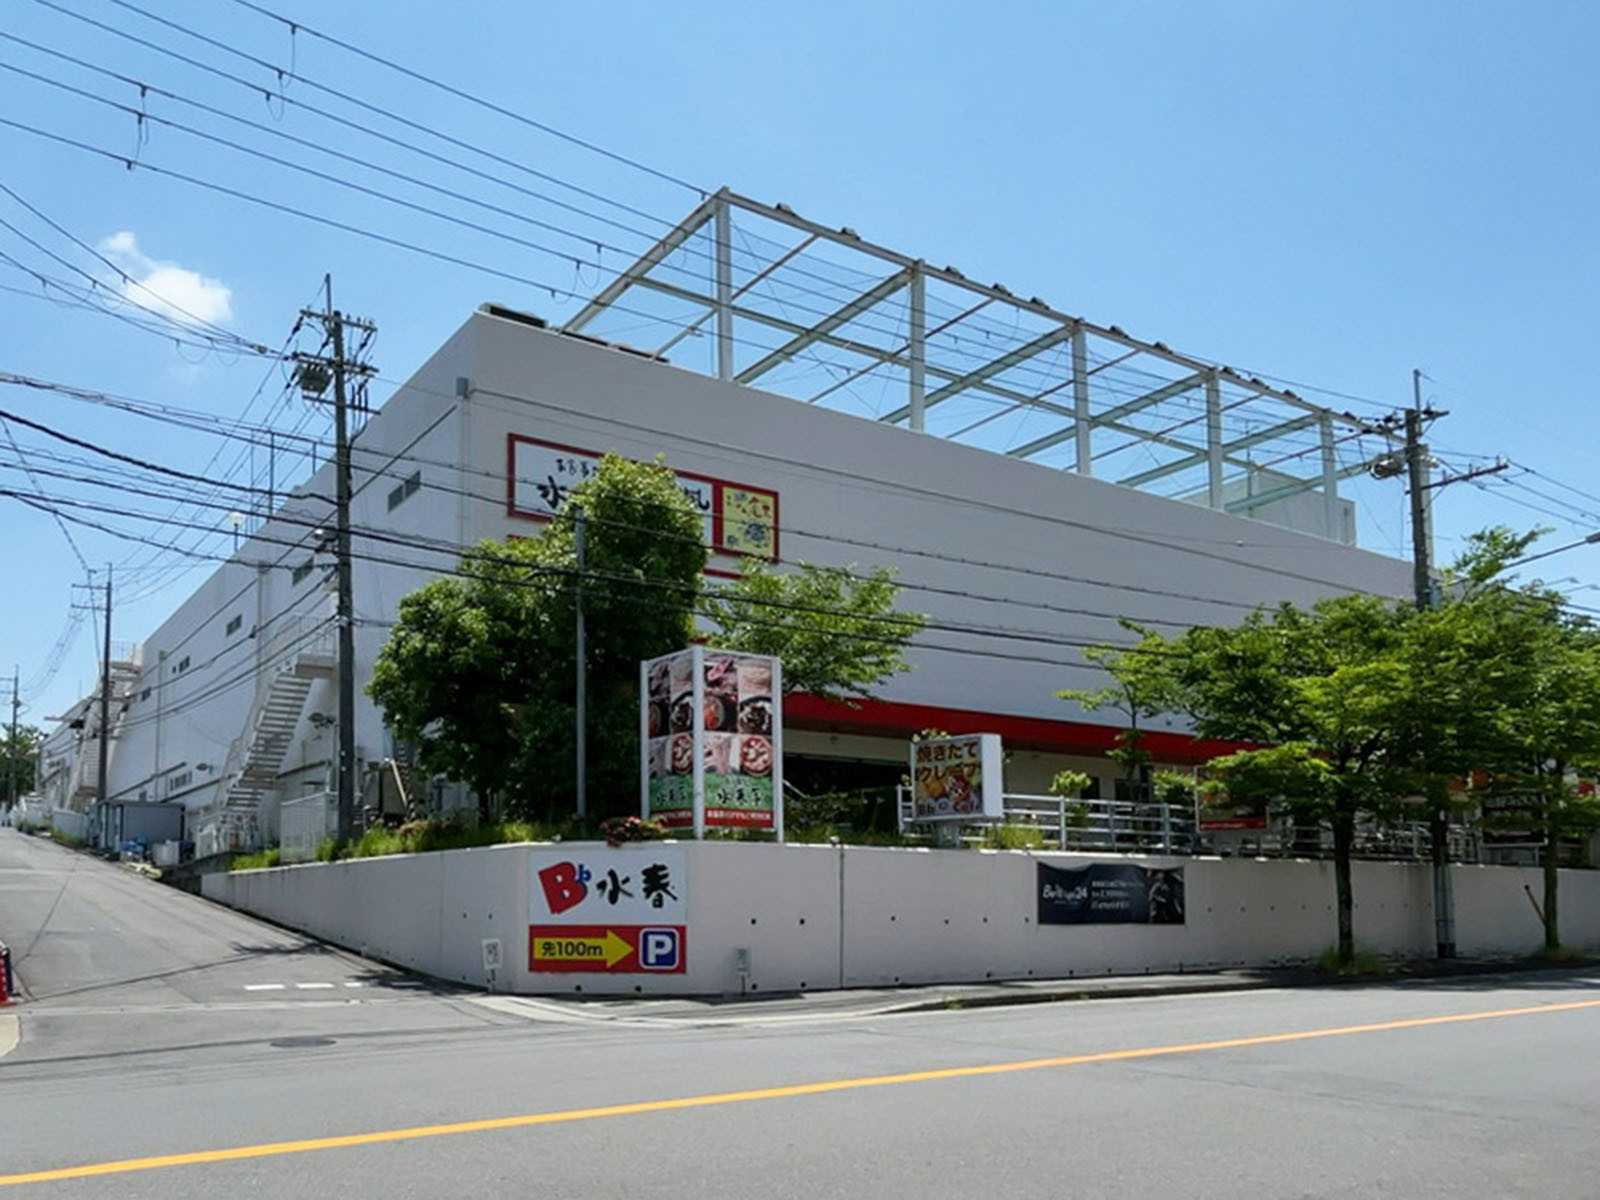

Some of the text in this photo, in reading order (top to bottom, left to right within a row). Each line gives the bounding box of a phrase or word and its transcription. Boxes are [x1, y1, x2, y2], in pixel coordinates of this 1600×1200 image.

[596, 864, 678, 909] 水春
[541, 934, 673, 964] 先100m P
